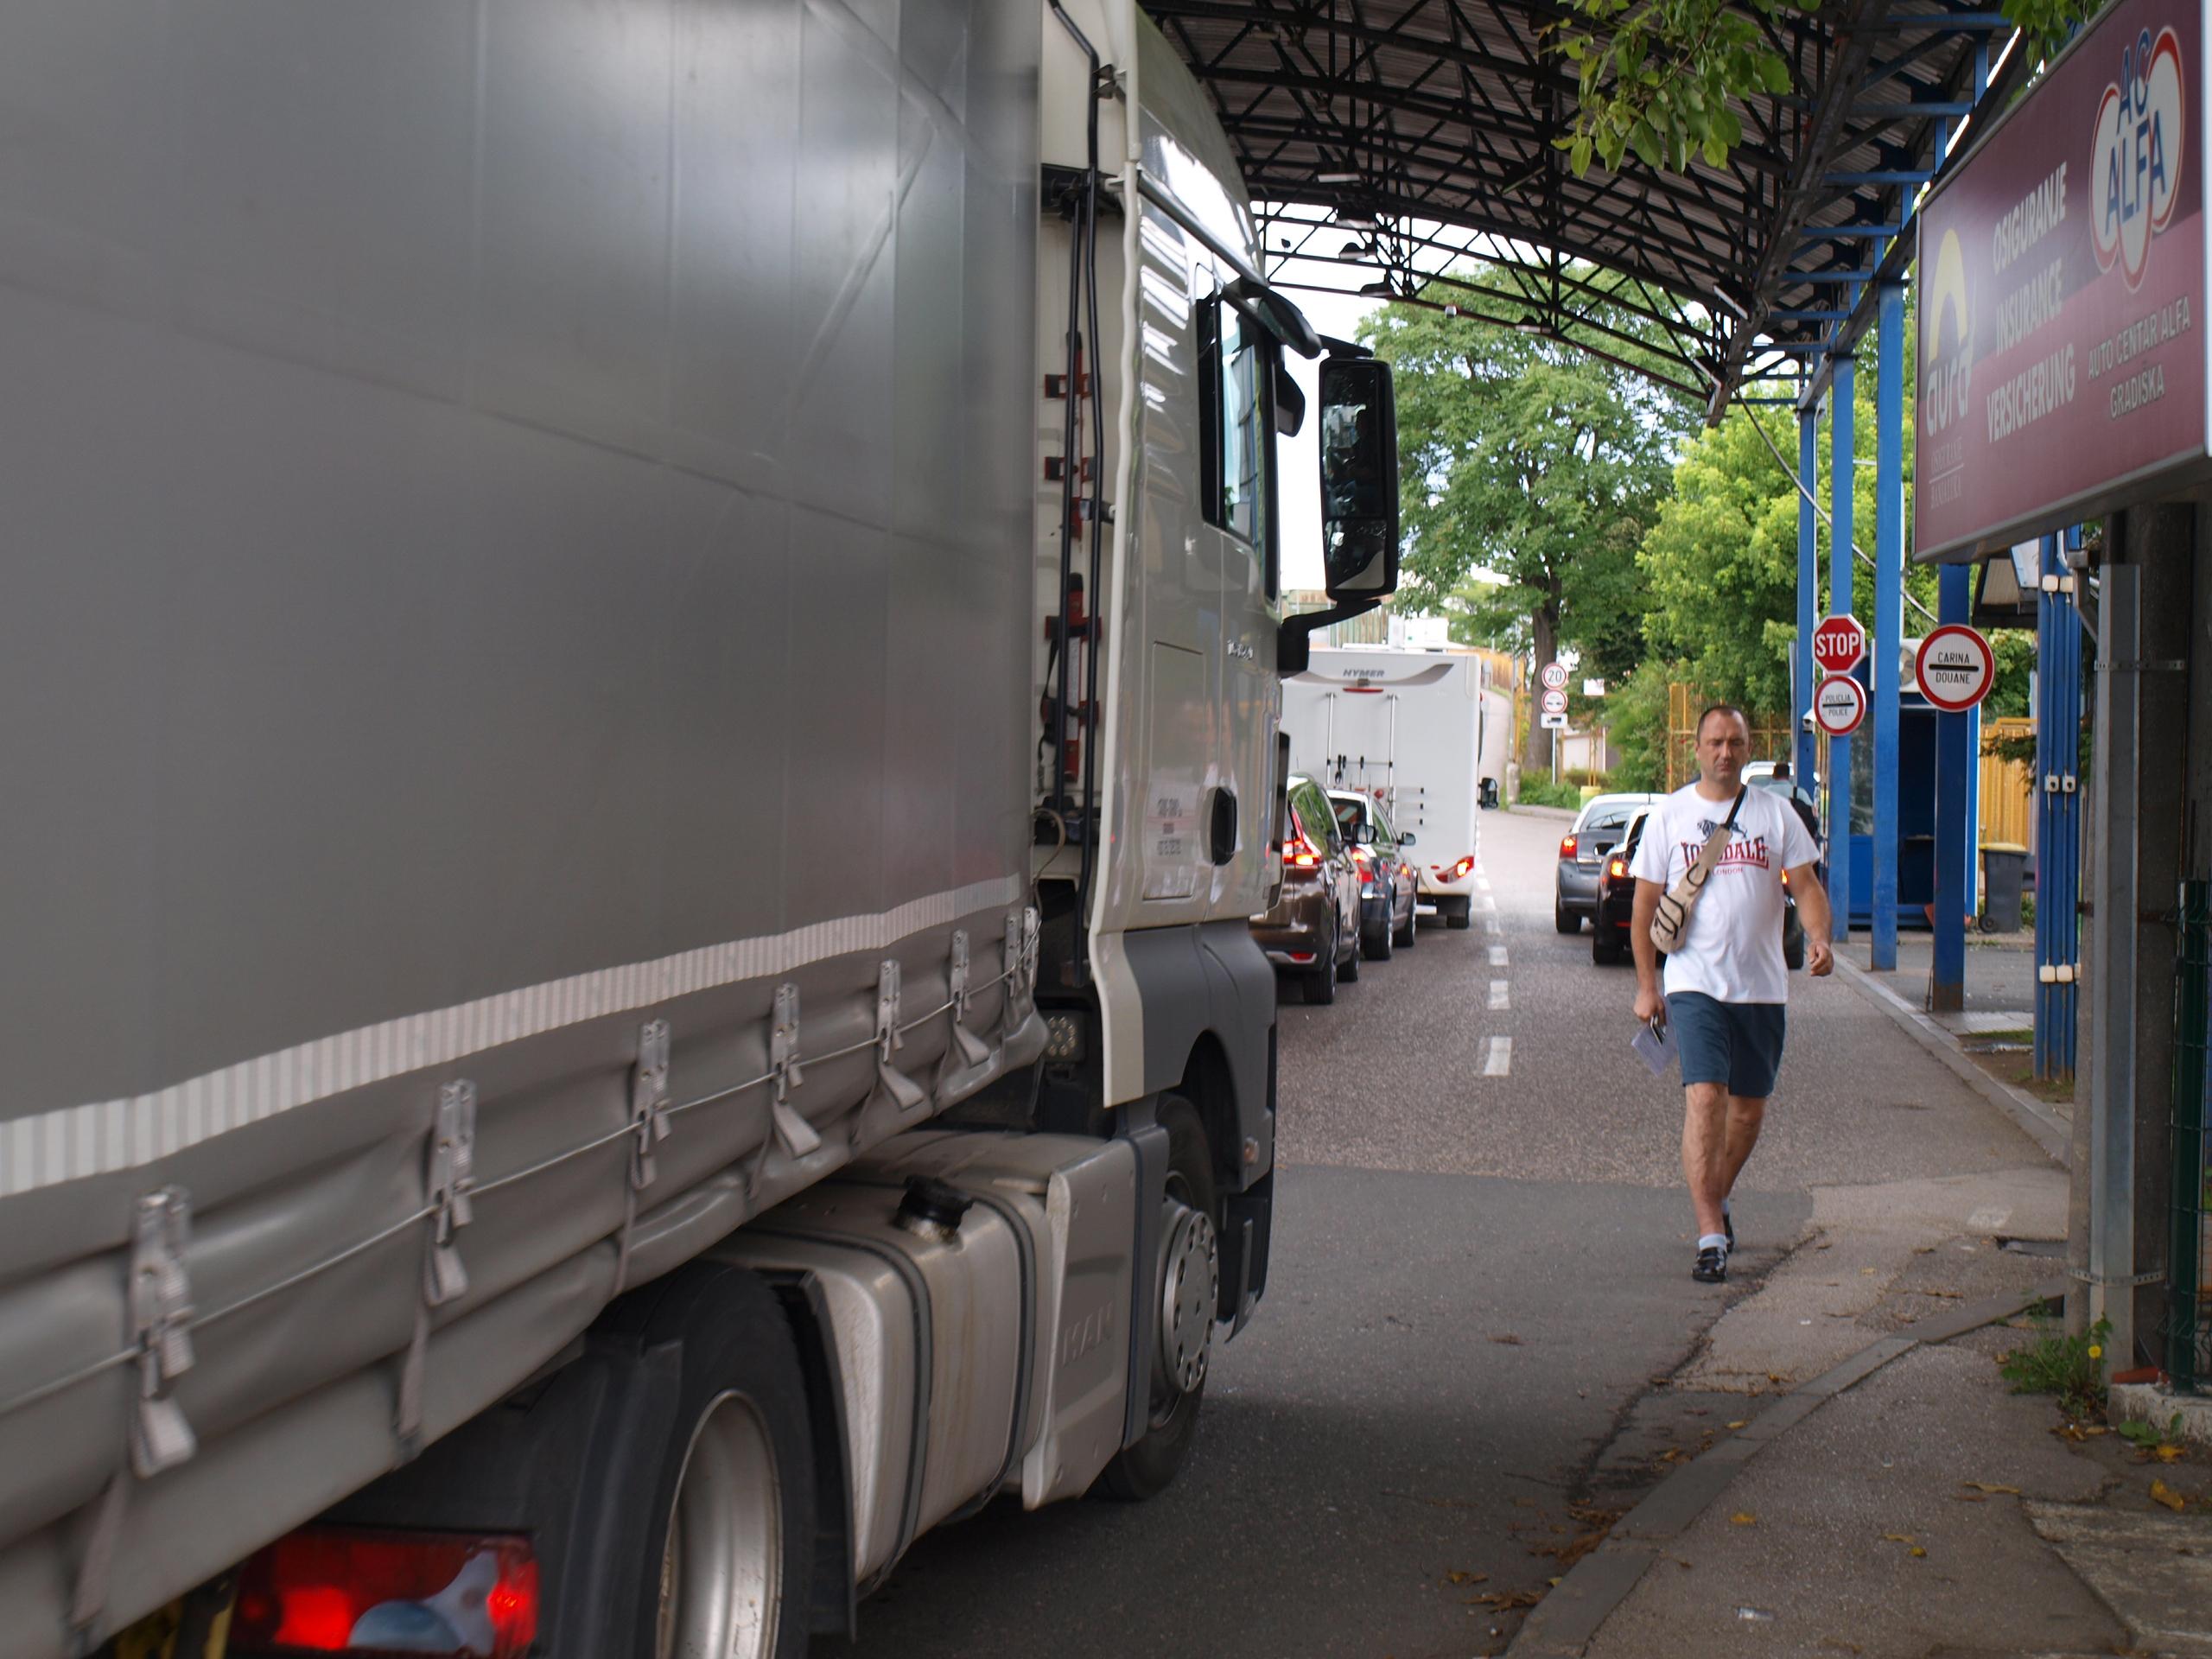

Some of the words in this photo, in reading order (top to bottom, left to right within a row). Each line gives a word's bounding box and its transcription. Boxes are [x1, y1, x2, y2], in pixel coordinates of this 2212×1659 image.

[2116, 27, 2151, 136] AC
[2105, 108, 2166, 237] ALFA
[1993, 161, 2067, 276] OSIGURANJE
[1996, 257, 2063, 357] INSURANCE
[2088, 338, 2114, 379] AUTO
[2116, 312, 2158, 365] CENTAR
[2160, 295, 2191, 342] ALFA
[1986, 343, 2075, 444] VERSICHERUNG
[1815, 632, 1860, 658] STOP
[1937, 652, 1970, 664] CARINA
[1342, 669, 1385, 677] HYMER
[1548, 670, 1562, 683] 20
[1936, 671, 1971, 684] DOUANE
[1825, 694, 1851, 702] POLICIJA
[1828, 708, 1848, 716] POLICE
[1680, 836, 1769, 868] LODALE
